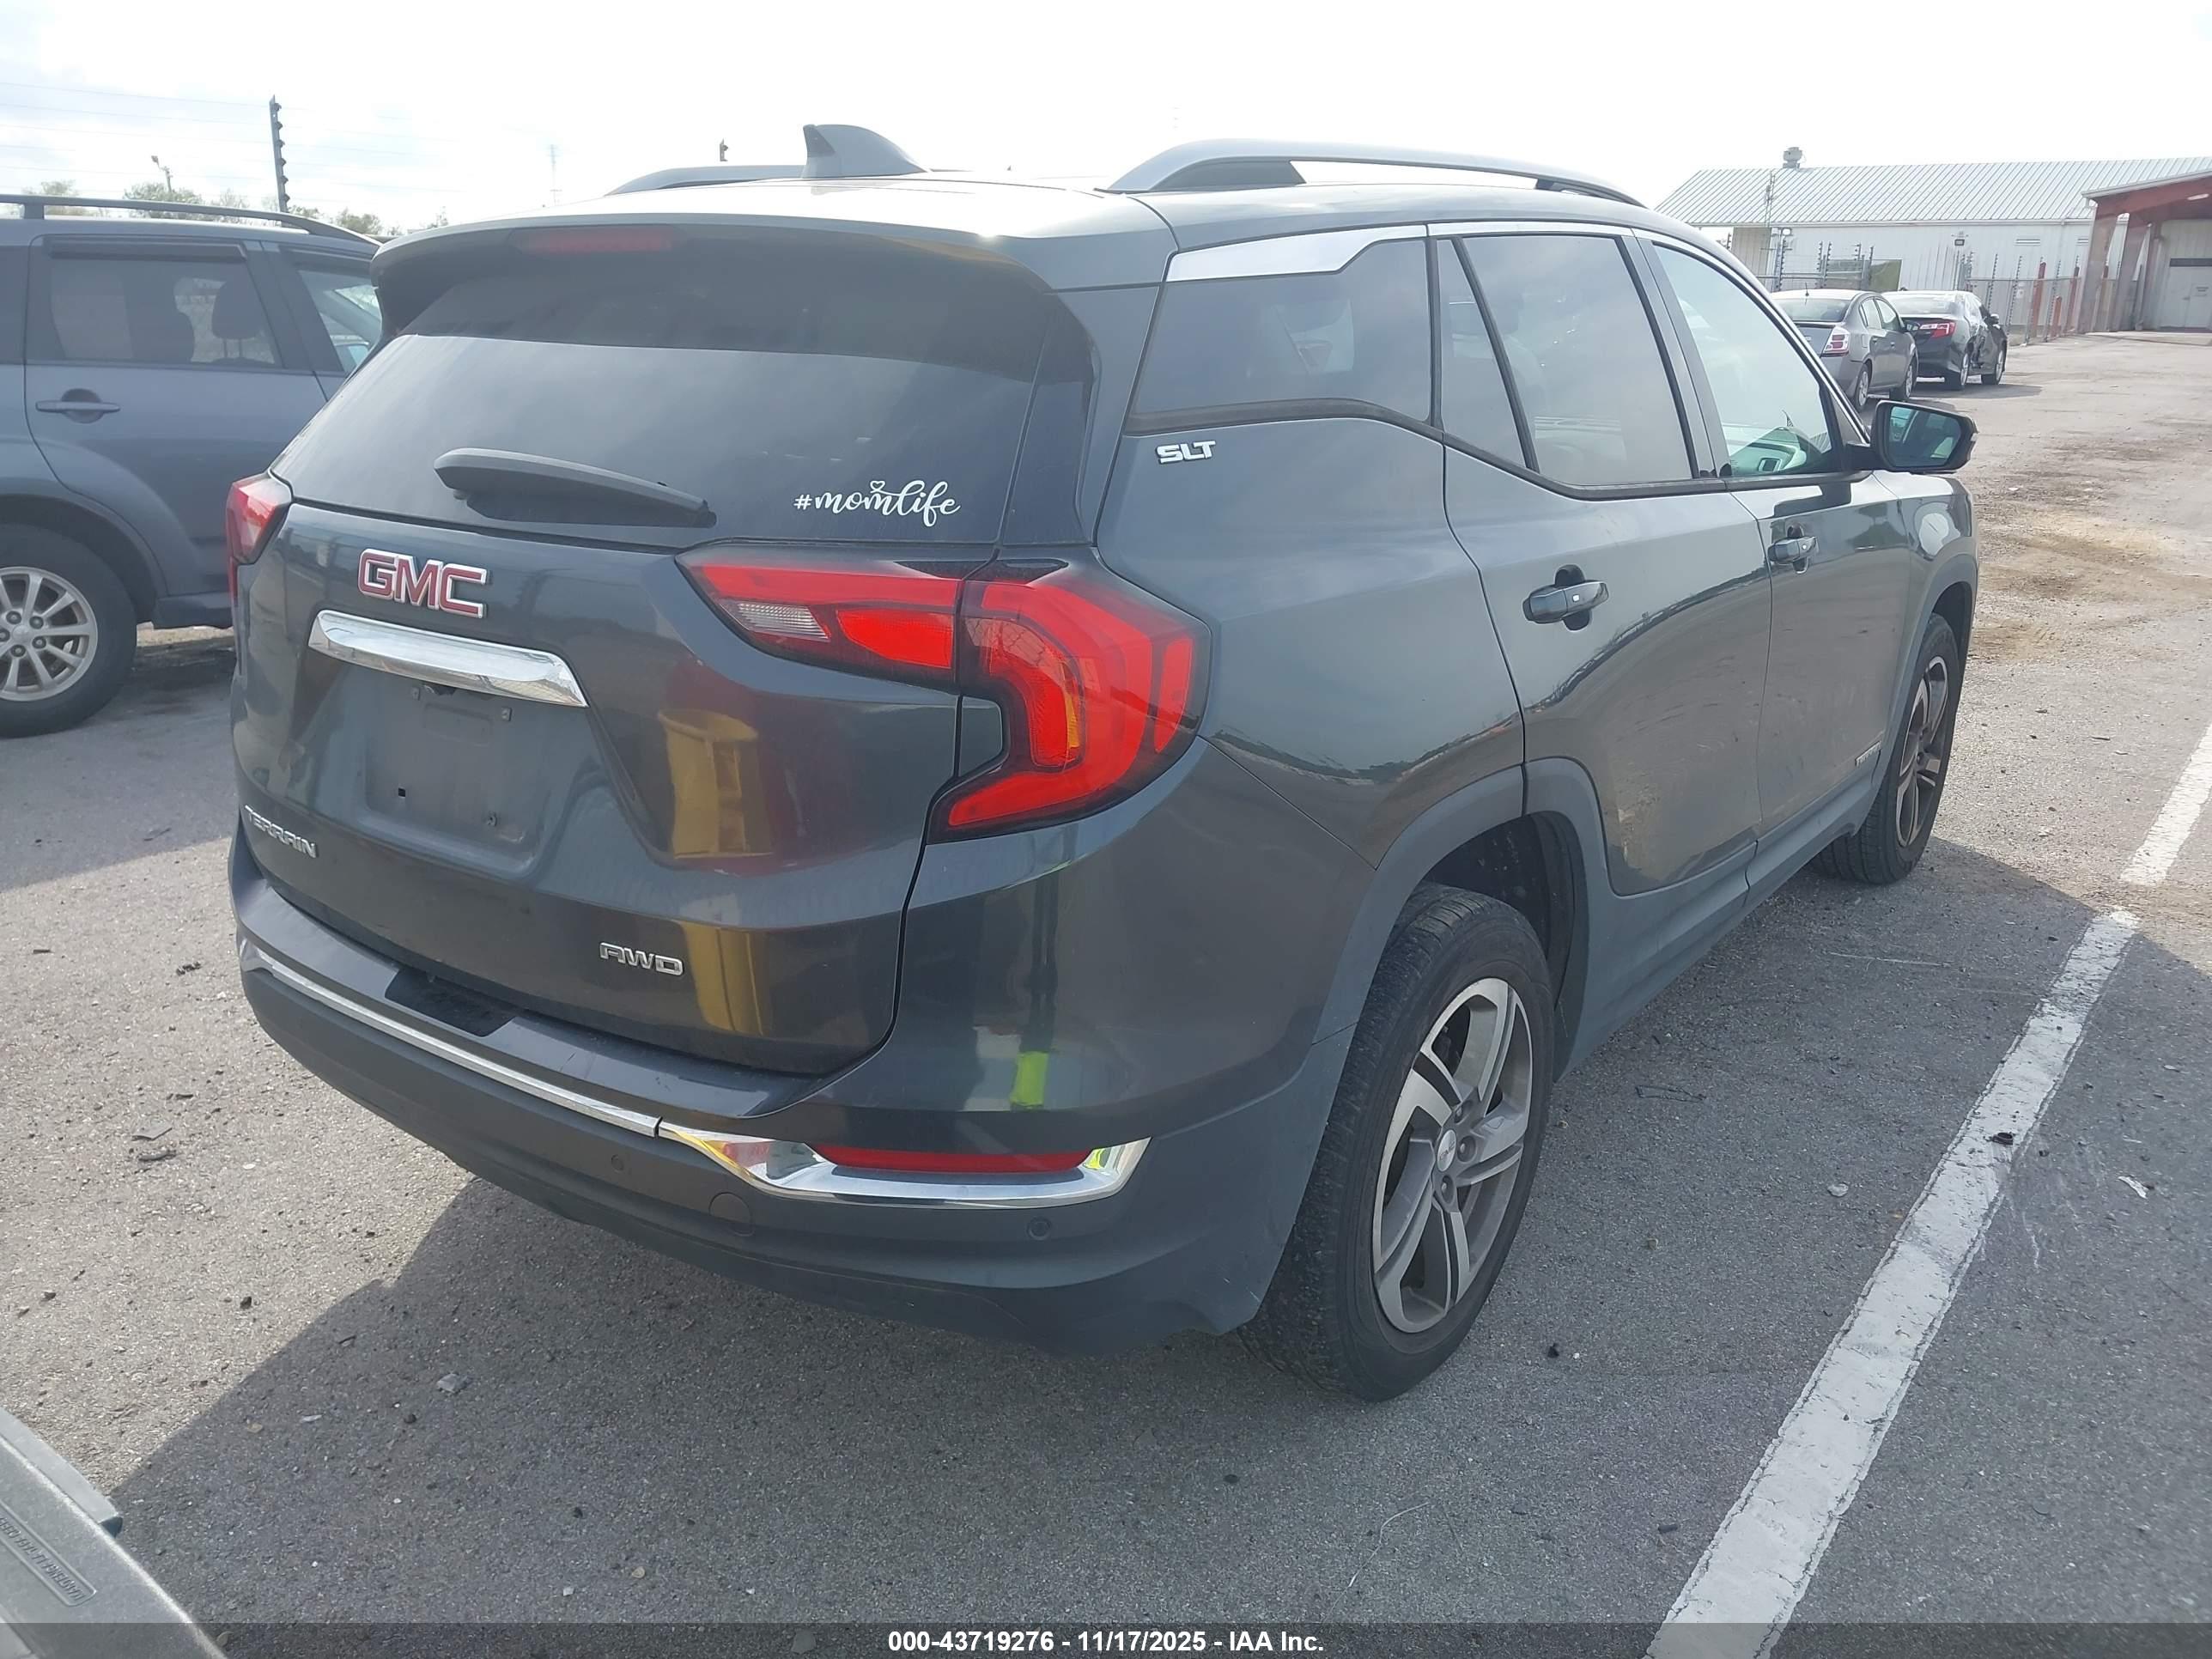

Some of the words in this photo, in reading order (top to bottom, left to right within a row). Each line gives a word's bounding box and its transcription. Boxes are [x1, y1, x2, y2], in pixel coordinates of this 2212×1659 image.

[1156, 440, 1216, 465] SLT
[793, 479, 961, 527] #momlife
[357, 548, 488, 619] GMC
[244, 805, 317, 859] TERRAIN
[599, 941, 684, 976] AWD
